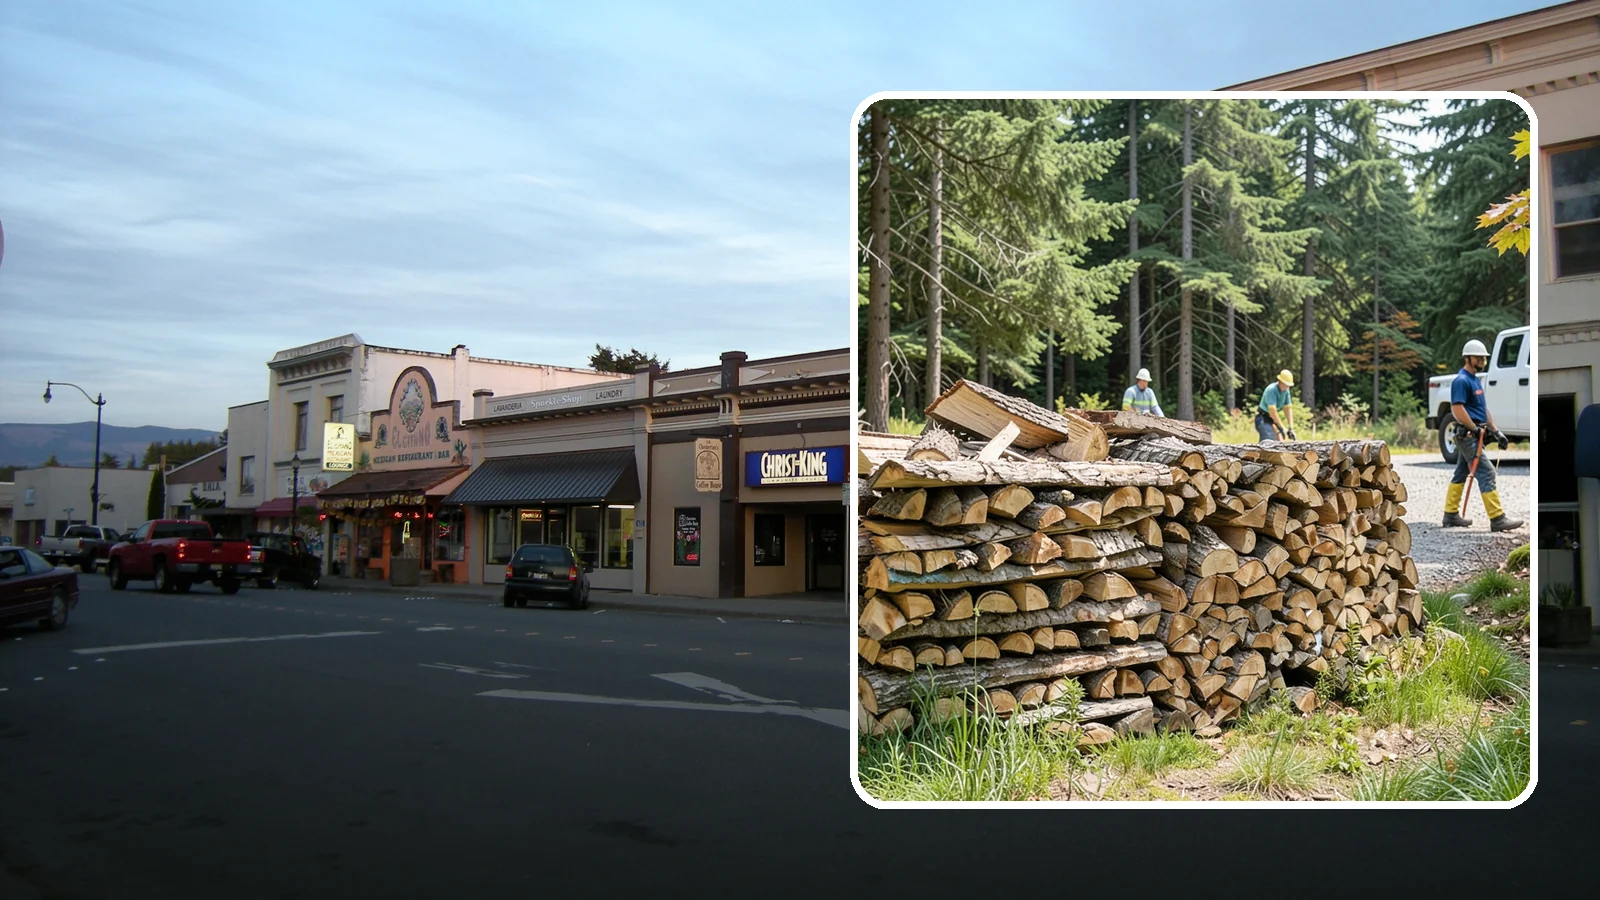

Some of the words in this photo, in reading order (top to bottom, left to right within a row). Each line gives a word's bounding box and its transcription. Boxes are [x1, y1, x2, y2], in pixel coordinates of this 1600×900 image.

[530, 396, 561, 409] Sparkle
[561, 394, 583, 404] Shop
[595, 389, 624, 400] LAUNDRY
[493, 402, 523, 412] LAVANDERIA
[392, 425, 402, 449] EL
[373, 455, 396, 464] MEXICAN
[397, 451, 433, 462] RESTAURANT
[438, 450, 450, 459] BAR
[799, 450, 828, 476] KING
